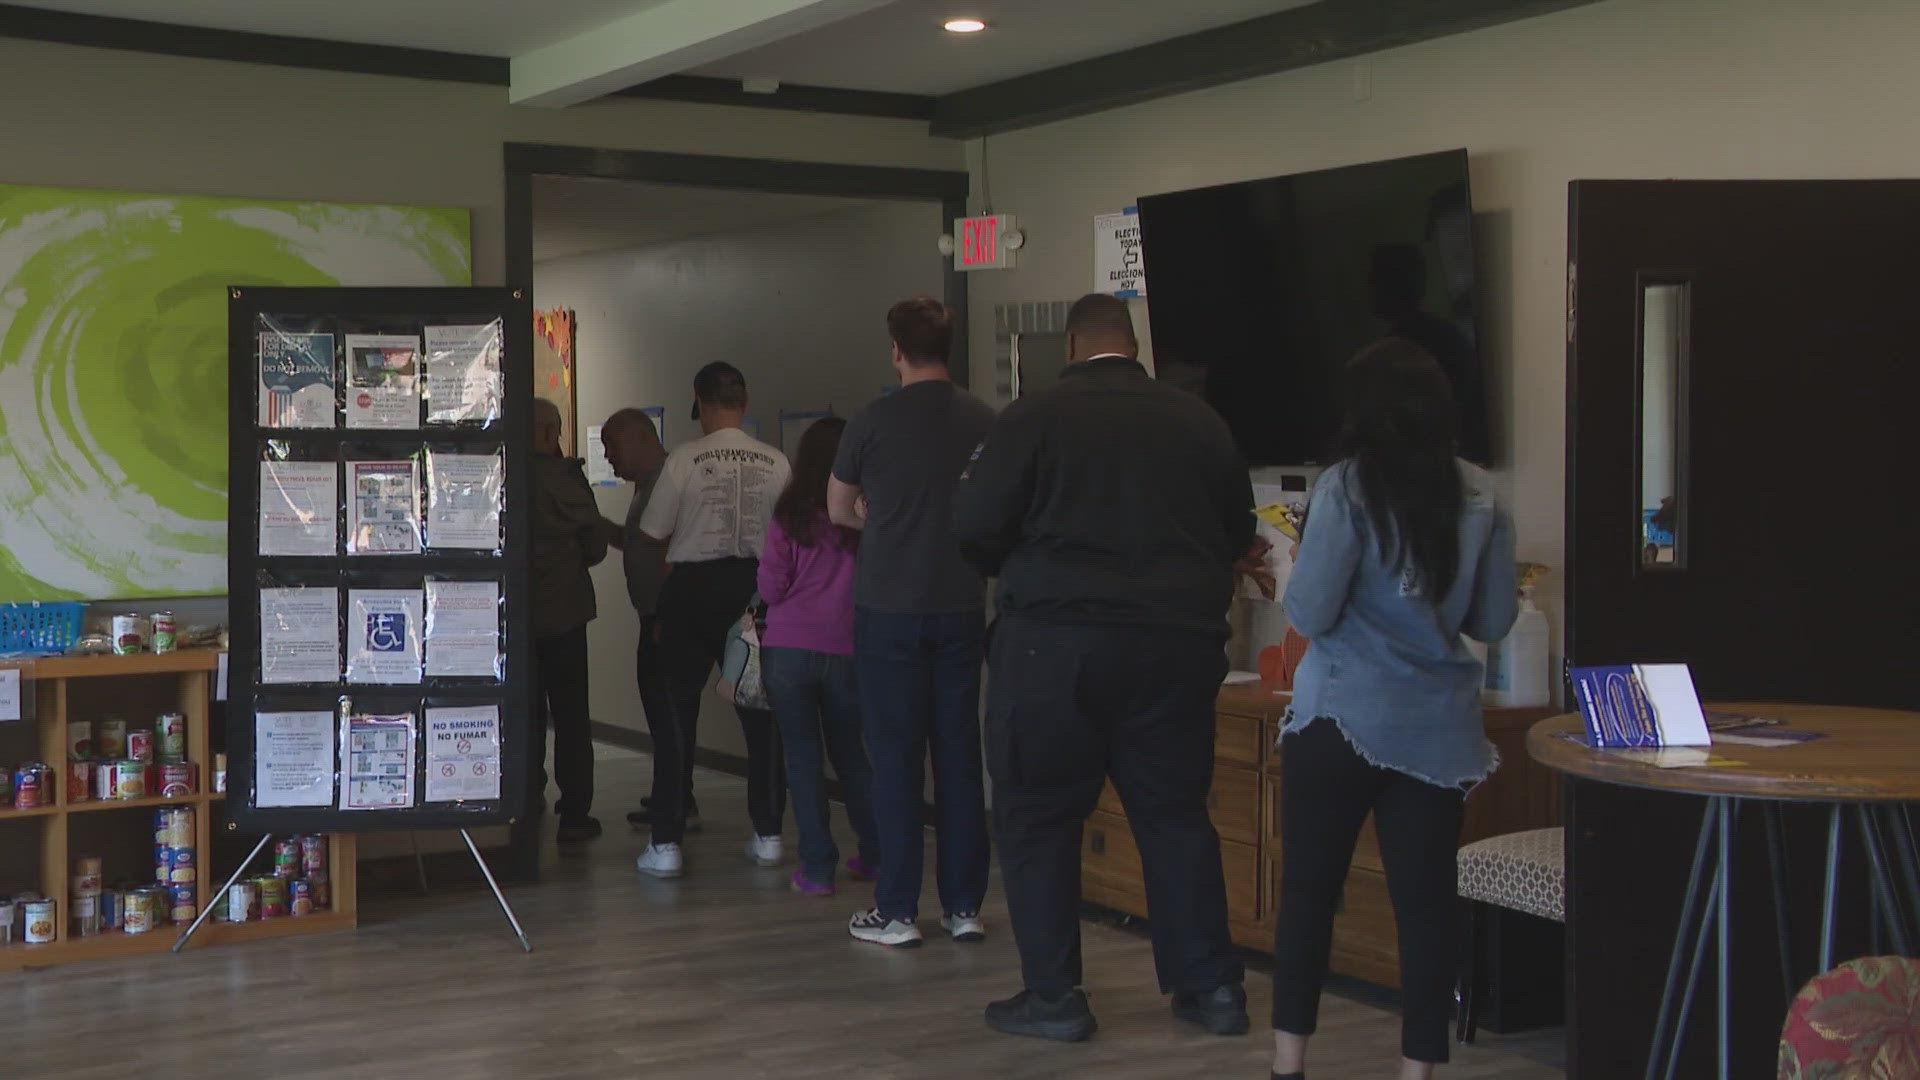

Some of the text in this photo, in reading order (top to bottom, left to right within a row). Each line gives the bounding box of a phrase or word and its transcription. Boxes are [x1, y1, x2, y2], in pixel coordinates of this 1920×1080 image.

[1115, 227, 1139, 240] ELECTI
[963, 217, 998, 265] EXIT
[1120, 239, 1143, 249] TODAY
[1120, 280, 1135, 288] HOY
[281, 344, 312, 352] DISPLAY
[263, 365, 276, 373] DO
[693, 448, 775, 466] WORLD CHAMPIONSHIP
[433, 719, 494, 730] NO SMOKING
[454, 731, 487, 740] FUMAR
